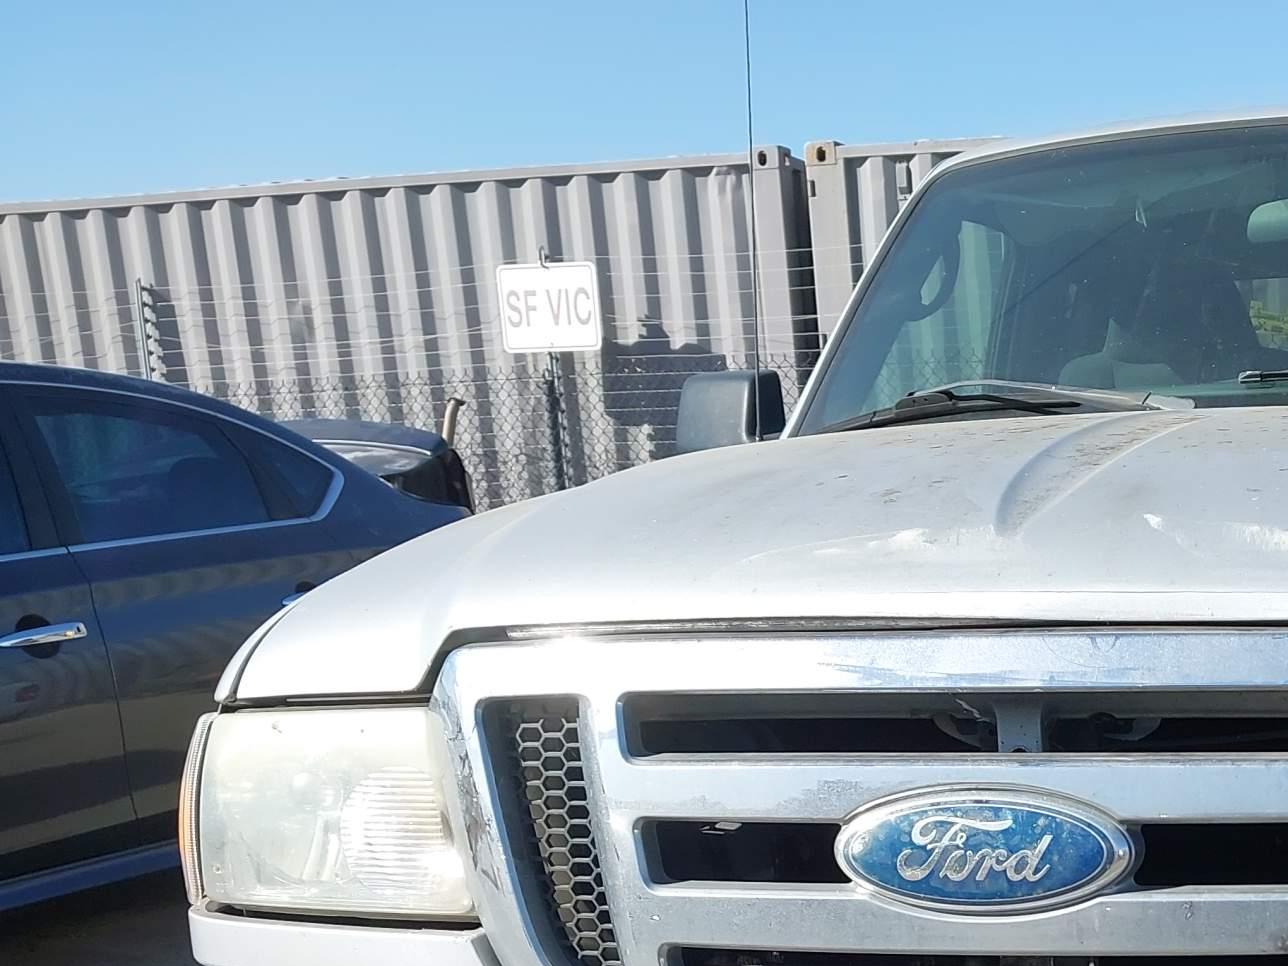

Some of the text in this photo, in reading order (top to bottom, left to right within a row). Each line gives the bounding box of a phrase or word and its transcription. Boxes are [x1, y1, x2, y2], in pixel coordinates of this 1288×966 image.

[506, 287, 592, 328] SF VIC
[896, 815, 1054, 882] Ford
